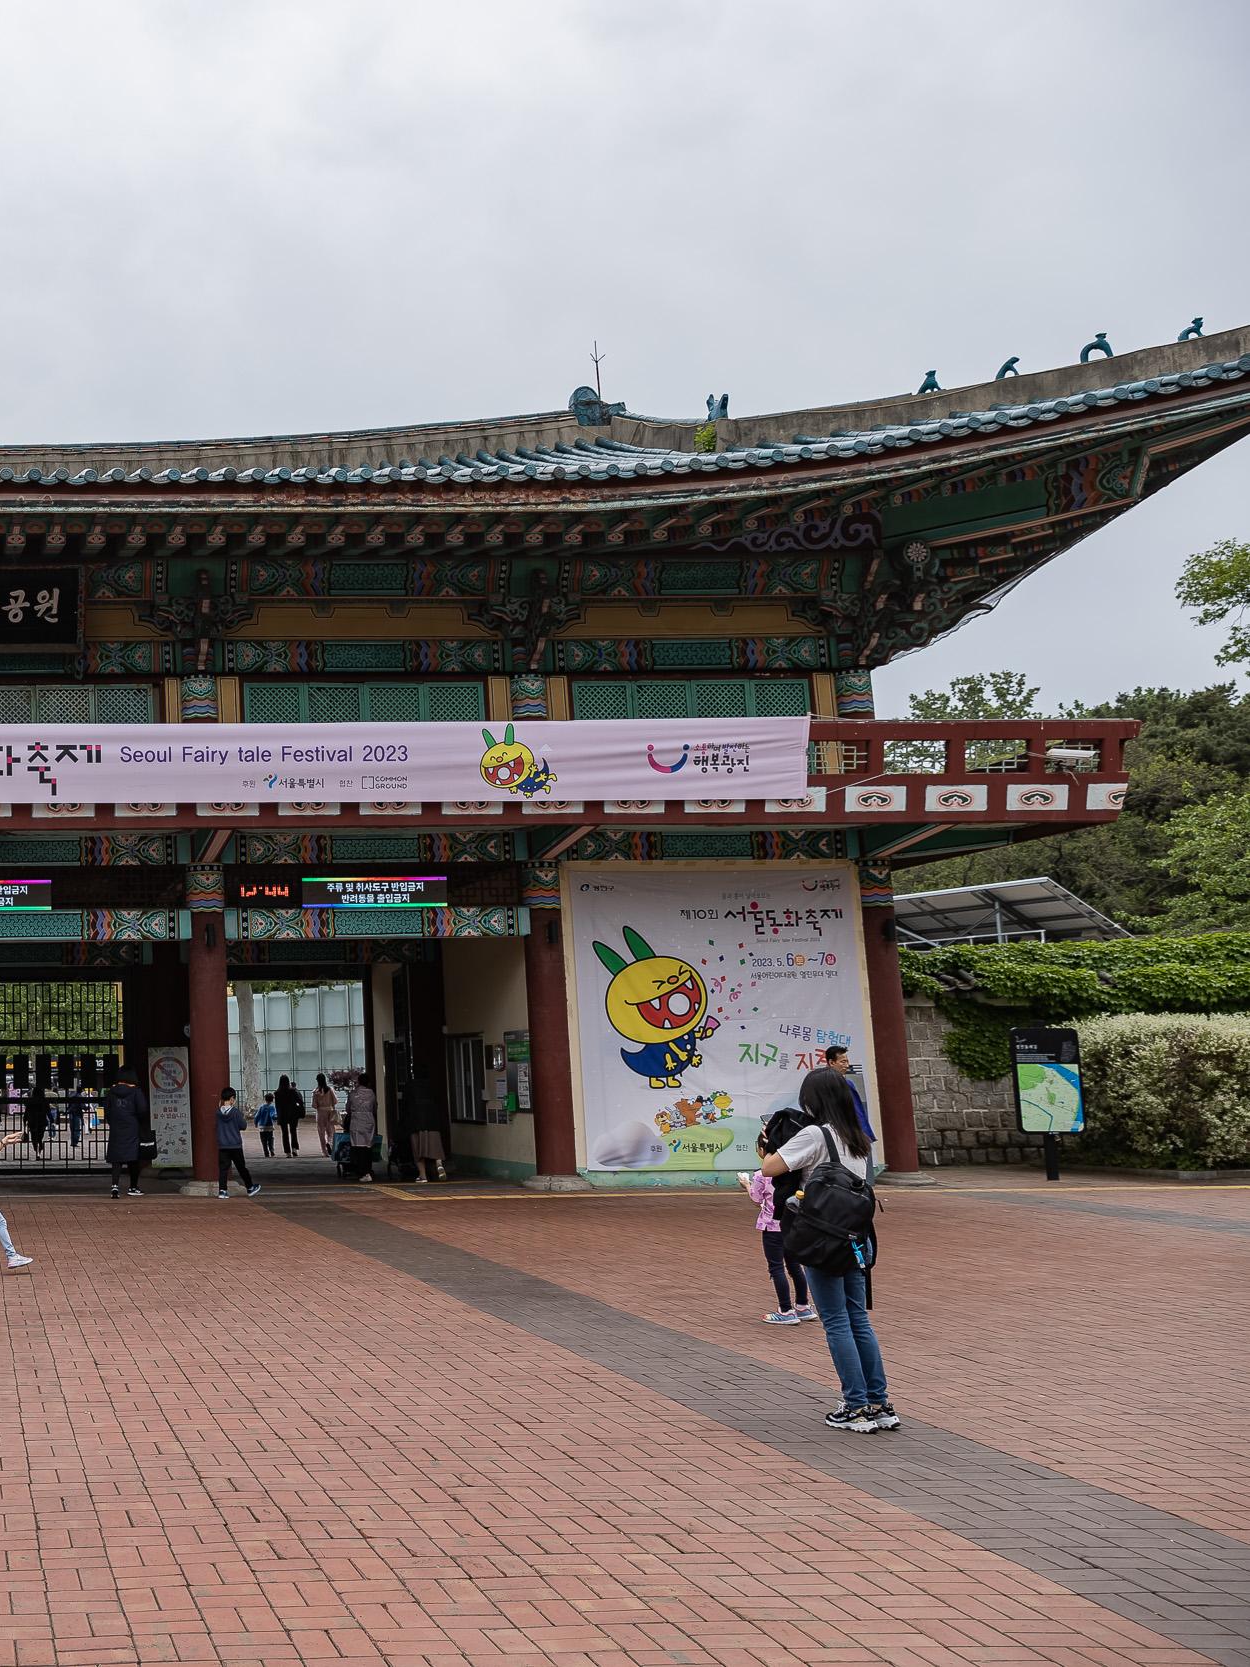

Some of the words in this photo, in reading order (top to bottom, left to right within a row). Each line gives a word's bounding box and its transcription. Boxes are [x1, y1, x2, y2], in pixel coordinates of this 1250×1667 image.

[120, 745, 172, 763] Seoul
[182, 745, 229, 765] Fairy
[238, 746, 271, 762] tale
[281, 745, 352, 762] Festival
[362, 745, 408, 762] 2023
[693, 753, 750, 774] 행복광진
[242, 780, 256, 788] 후원
[278, 778, 325, 789] 서울특별시
[339, 780, 353, 788] 협찬
[327, 882, 344, 893] 주류
[345, 882, 355, 892] 및
[355, 881, 389, 892] 취사도구
[391, 881, 425, 891] 반입금지
[341, 893, 375, 904] 반려동물
[377, 893, 410, 903] 출입금지
[745, 892, 771, 900] 날아오르는
[679, 909, 719, 920] 제10회
[723, 901, 843, 937] 서울동화축제
[752, 958, 775, 968] 2023.
[777, 958, 785, 967] 5.
[750, 971, 798, 980] 서울어린이대공원
[799, 970, 824, 979] 열린무대
[825, 970, 838, 979] 일대
[779, 1023, 811, 1042] 나루몽
[816, 1028, 851, 1047] 탐험대
[738, 1043, 790, 1070] 지구를
[682, 1142, 723, 1153] 서울특별시
